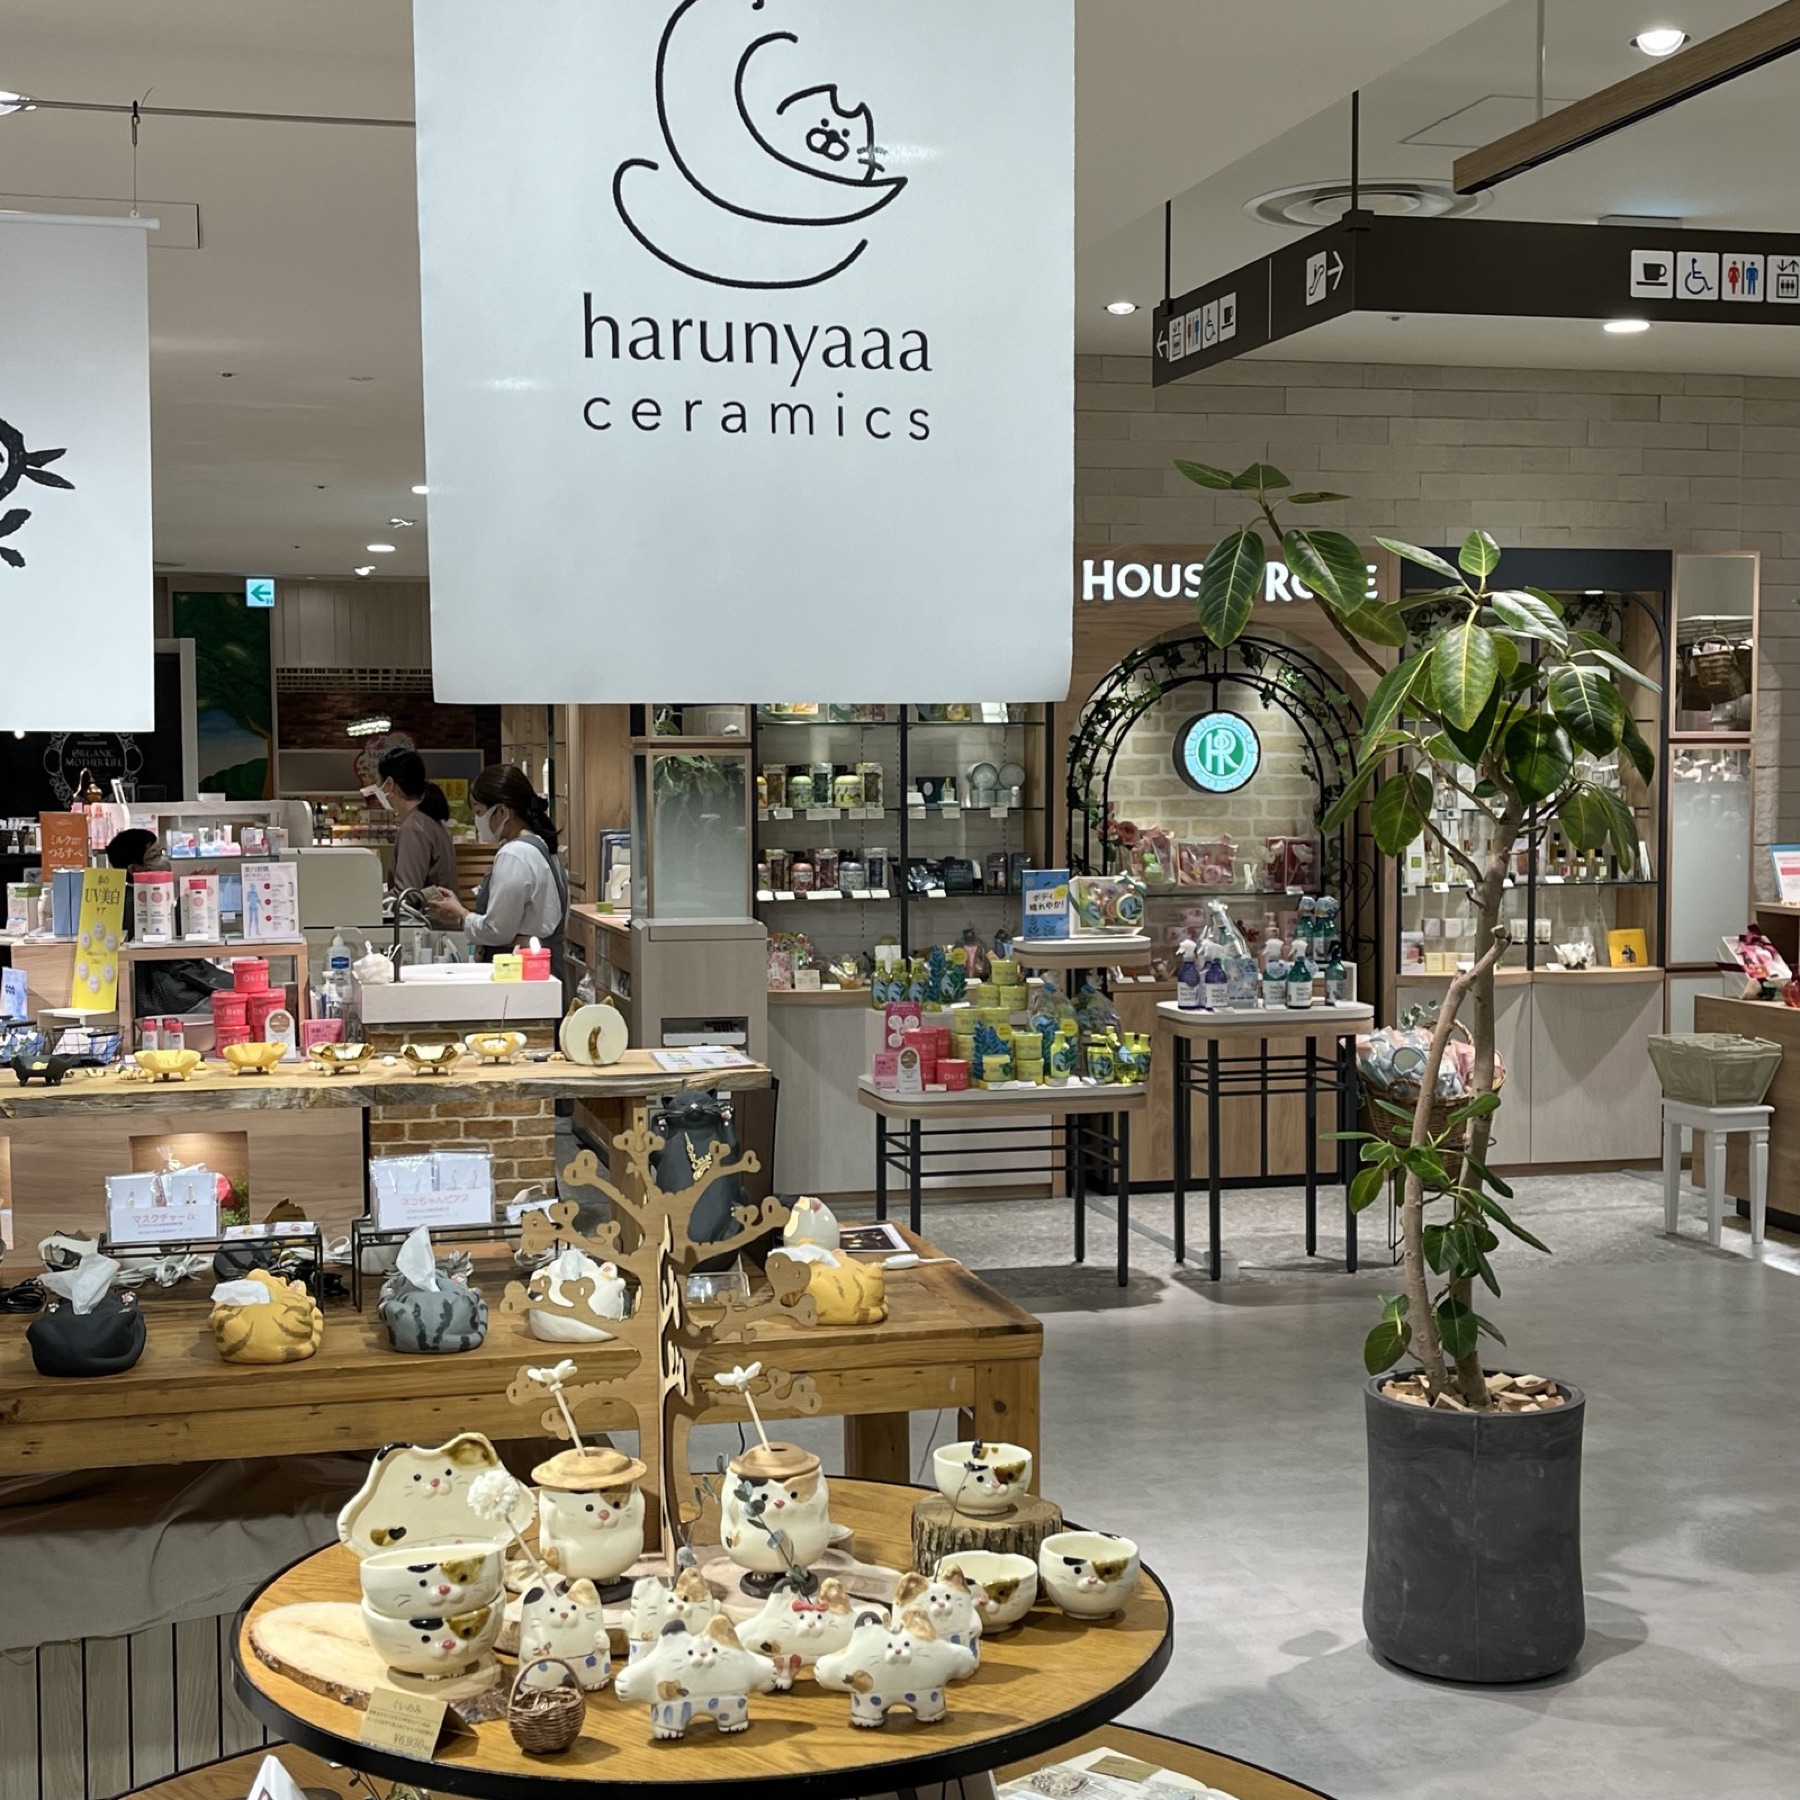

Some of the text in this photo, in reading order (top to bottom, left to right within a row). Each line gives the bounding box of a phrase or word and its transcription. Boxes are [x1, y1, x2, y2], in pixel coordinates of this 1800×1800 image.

[583, 292, 933, 387] harunyaaa
[583, 391, 931, 441] ceramics
[1082, 559, 1204, 601] HOUS
[85, 888, 120, 906] UV美白
